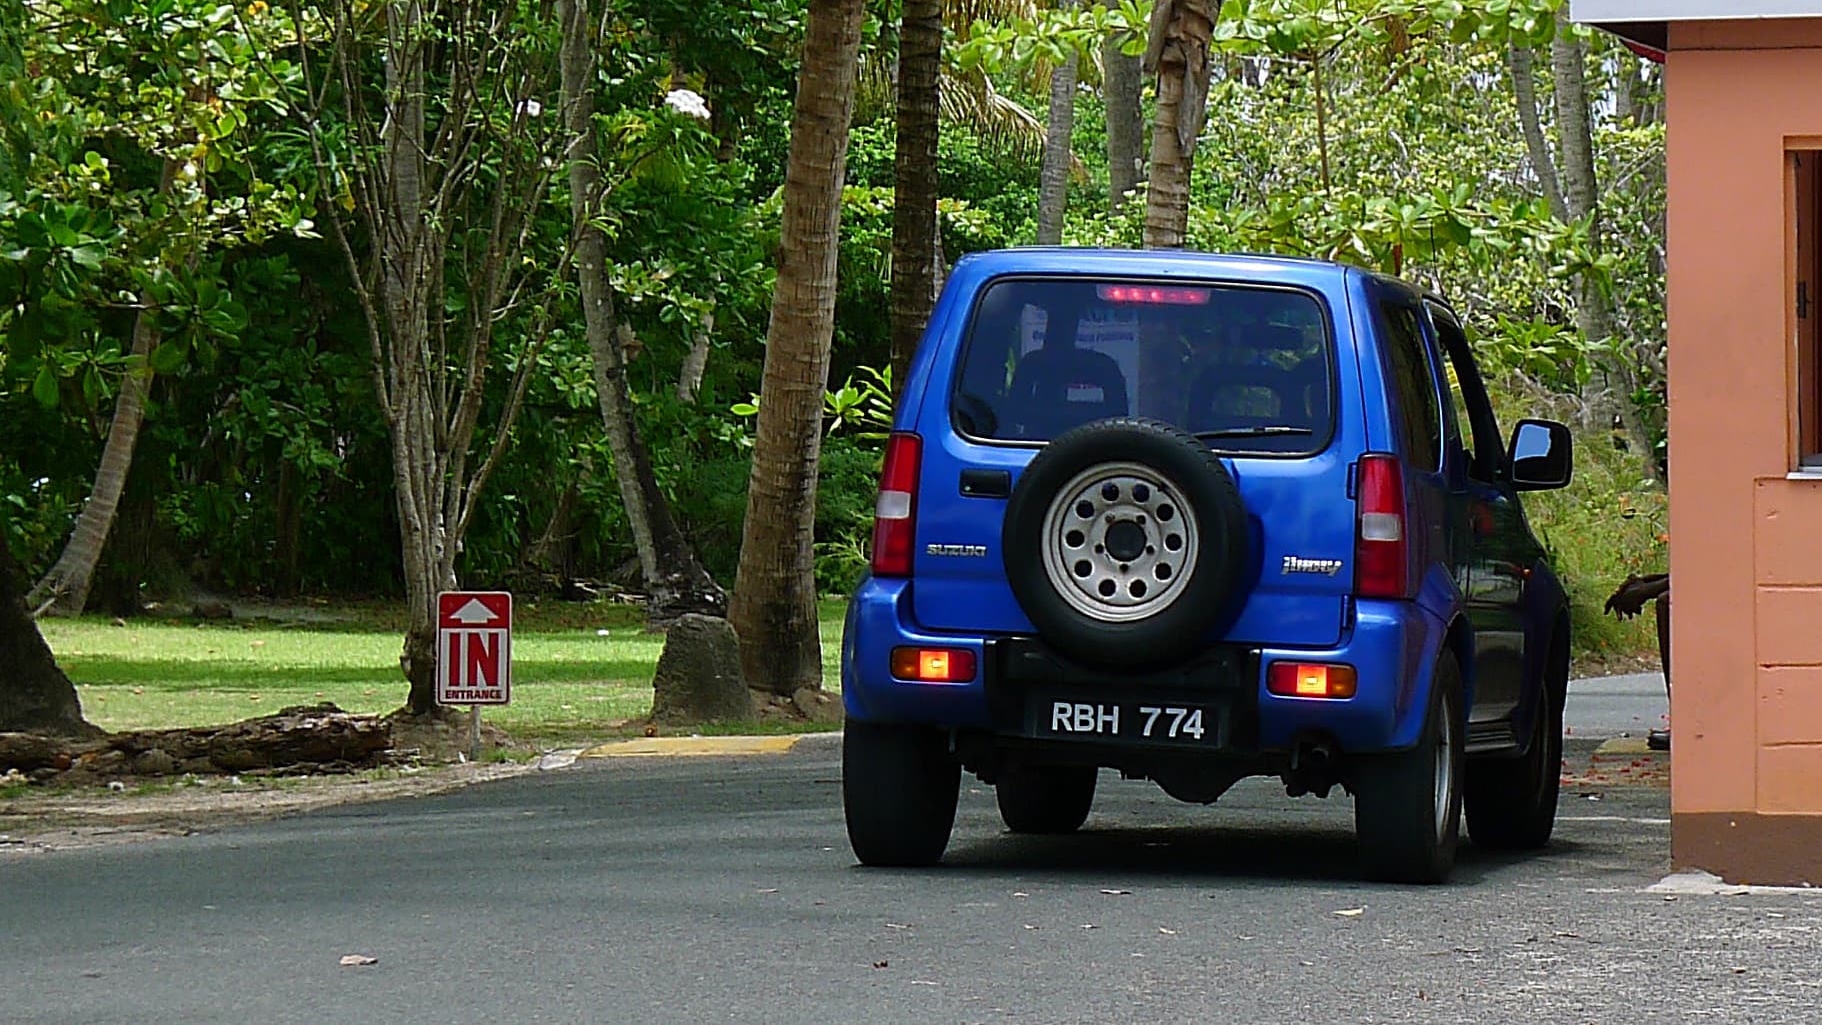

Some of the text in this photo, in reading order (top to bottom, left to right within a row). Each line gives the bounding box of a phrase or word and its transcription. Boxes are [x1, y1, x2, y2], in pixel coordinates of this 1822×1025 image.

[926, 544, 987, 556] SUZUKI
[448, 632, 499, 686] IN
[445, 690, 502, 700] ENTRANCE
[1052, 702, 1205, 740] RBH 774
